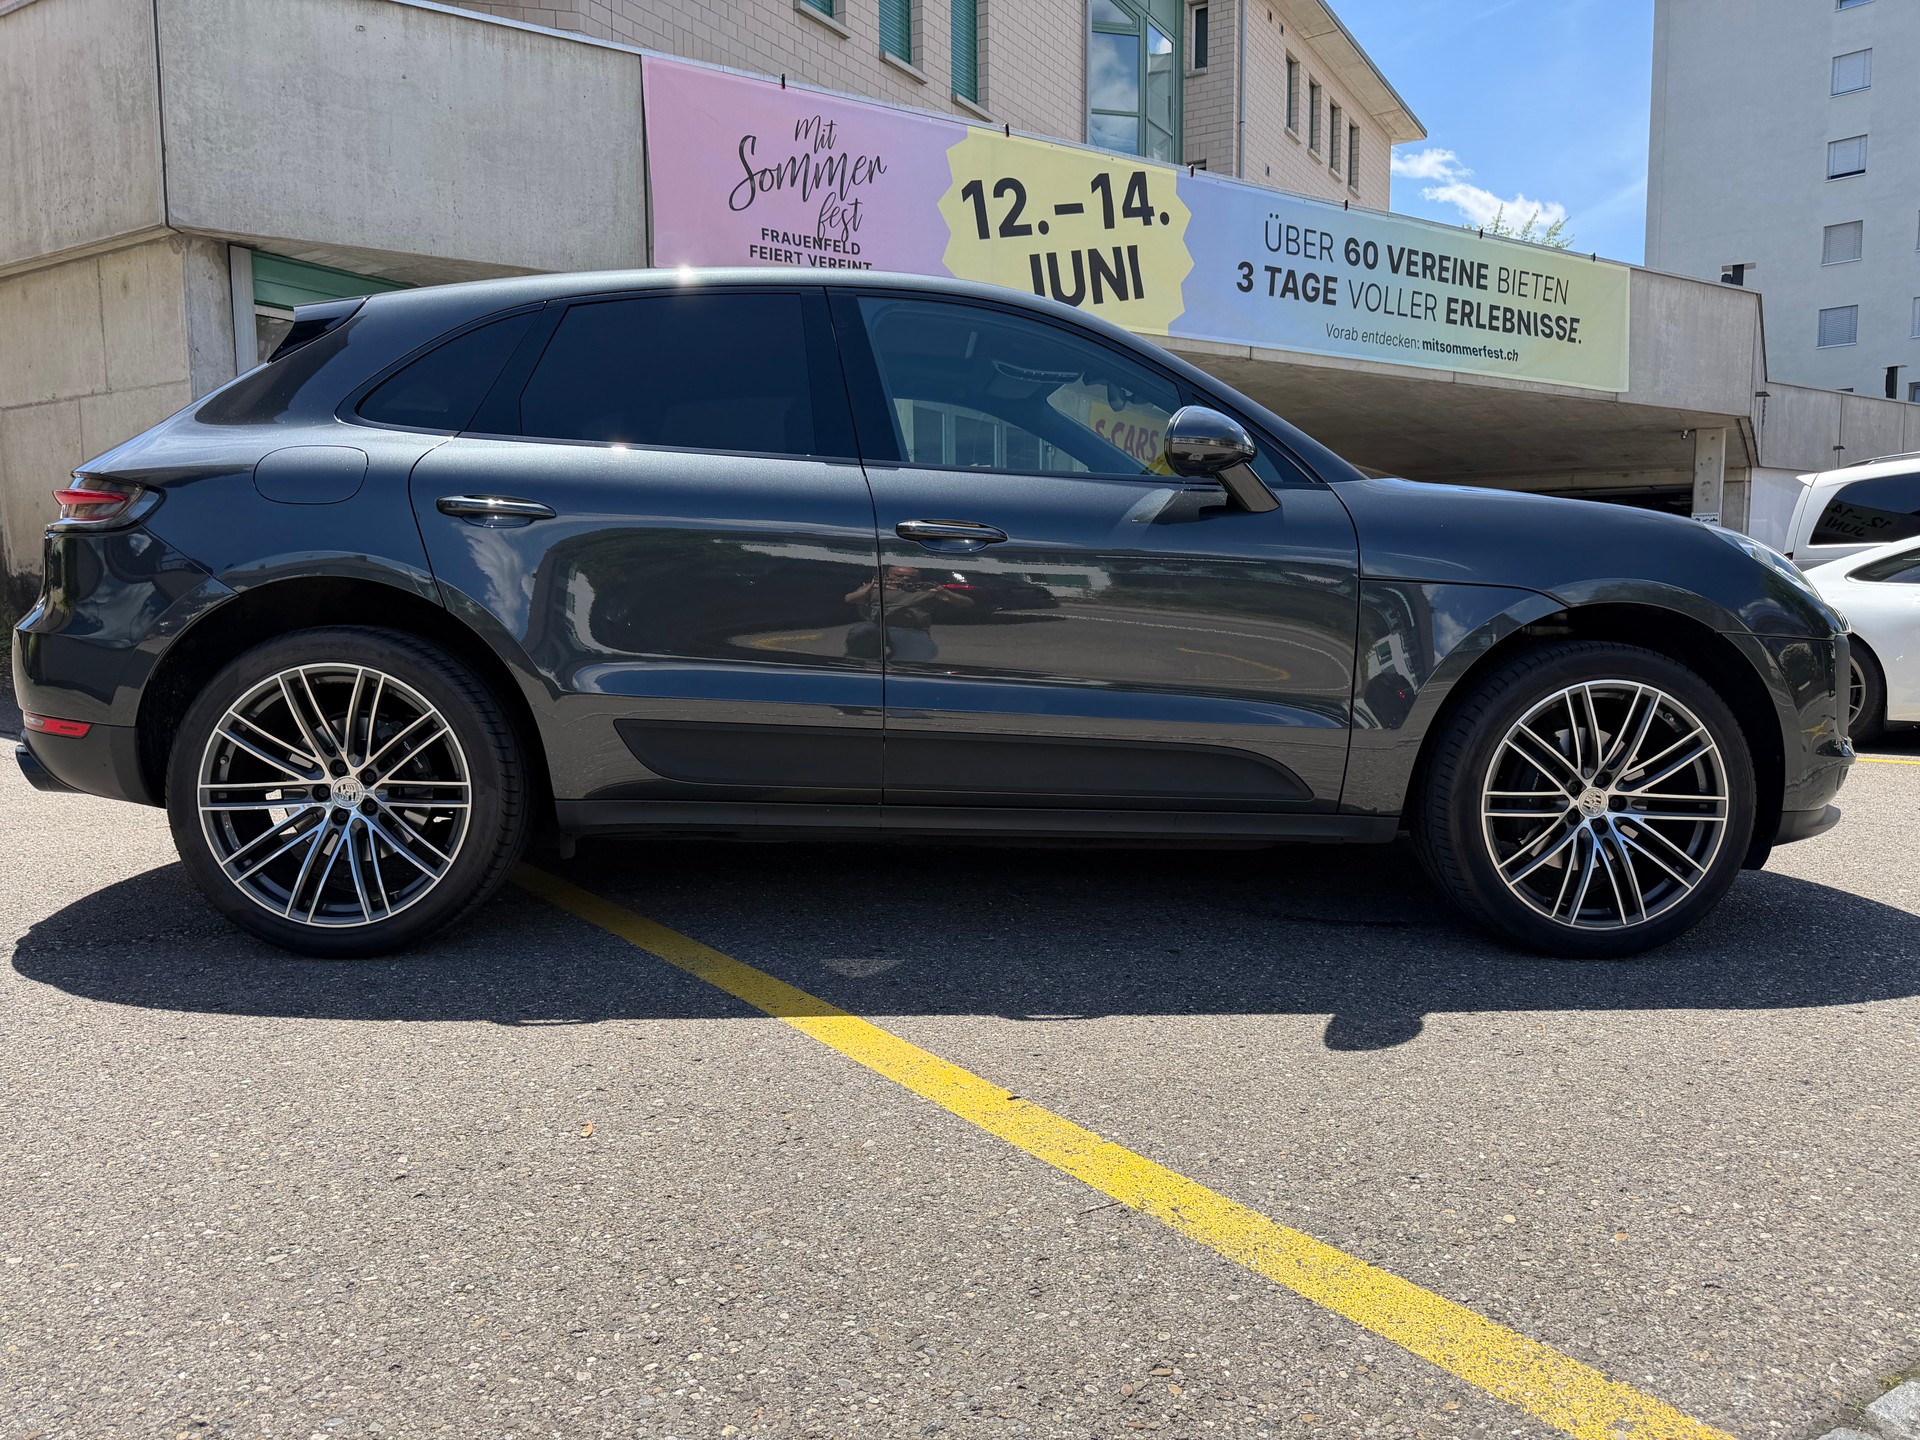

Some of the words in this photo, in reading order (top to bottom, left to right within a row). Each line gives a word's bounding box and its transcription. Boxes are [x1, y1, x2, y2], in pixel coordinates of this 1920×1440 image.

[794, 114, 837, 154] Mit
[728, 134, 888, 212] Sommer
[761, 227, 861, 256] FRAUENFELD
[816, 191, 863, 252] fest
[749, 244, 803, 265] FEIERT
[1029, 244, 1145, 307] JUNI
[1264, 212, 1334, 263] ÜBER
[1343, 236, 1379, 271] 60
[1386, 244, 1489, 291] VEREINE
[1497, 266, 1570, 306] BIETEN
[1236, 260, 1255, 293] 3
[1264, 264, 1338, 307] TAGE
[1347, 279, 1438, 322] VOLLER
[1445, 297, 1583, 345] ERLEBNISSE.
[1325, 323, 1359, 342] Vorab
[1361, 331, 1421, 350] entdecken:
[1422, 339, 1520, 362] mitsommerfest.ch
